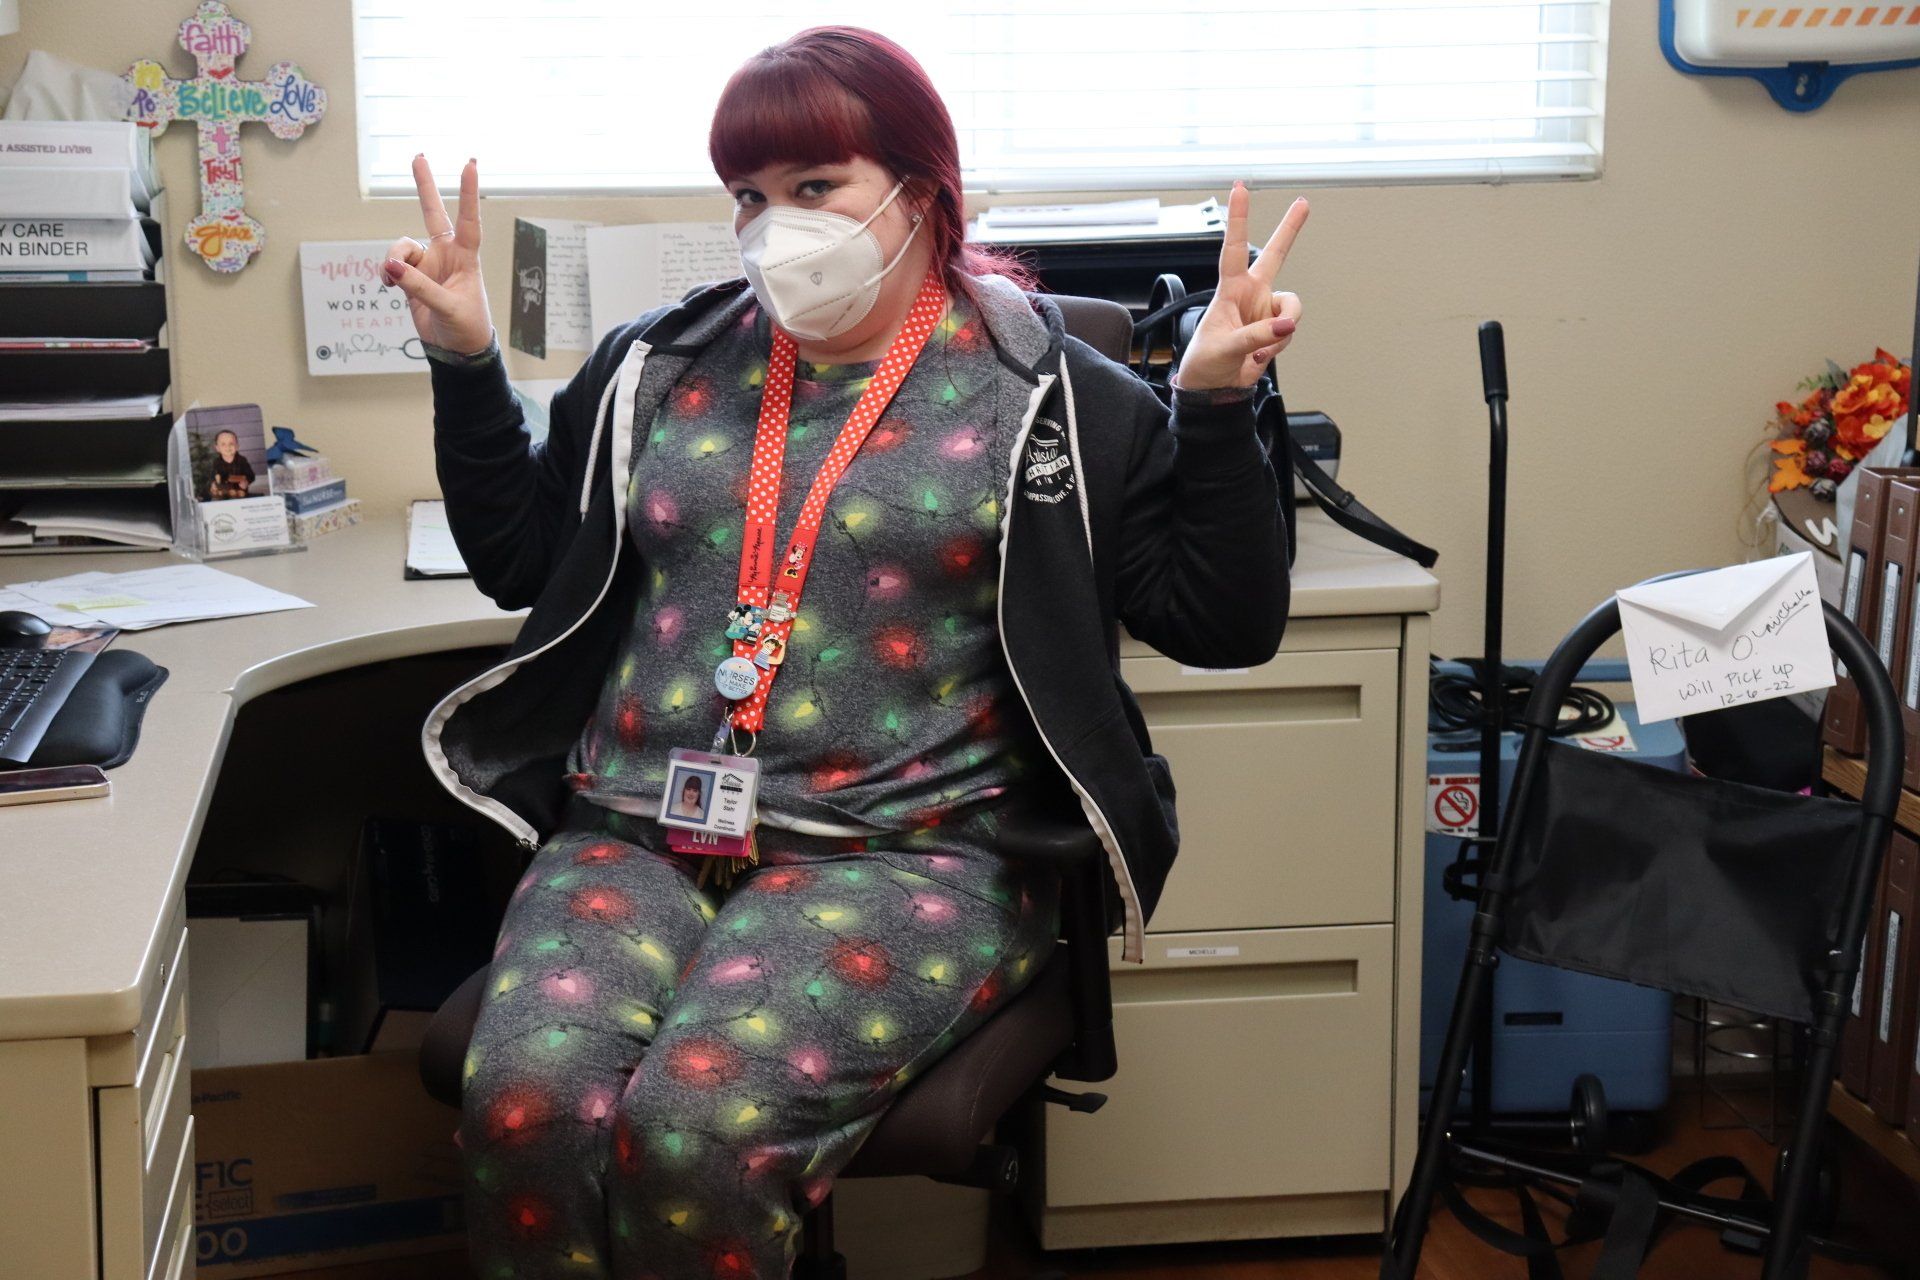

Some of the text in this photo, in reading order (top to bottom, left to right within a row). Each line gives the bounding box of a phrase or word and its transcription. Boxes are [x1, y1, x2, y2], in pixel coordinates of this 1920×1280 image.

[6, 143, 92, 154] ASSISTED LIVING
[13, 223, 64, 238] CARE
[19, 241, 89, 257] BINDER
[350, 283, 389, 295] IS A
[327, 300, 380, 312] WORK
[341, 315, 405, 330] HEART
[1648, 641, 1710, 675] Rita
[692, 830, 718, 846] LVN
